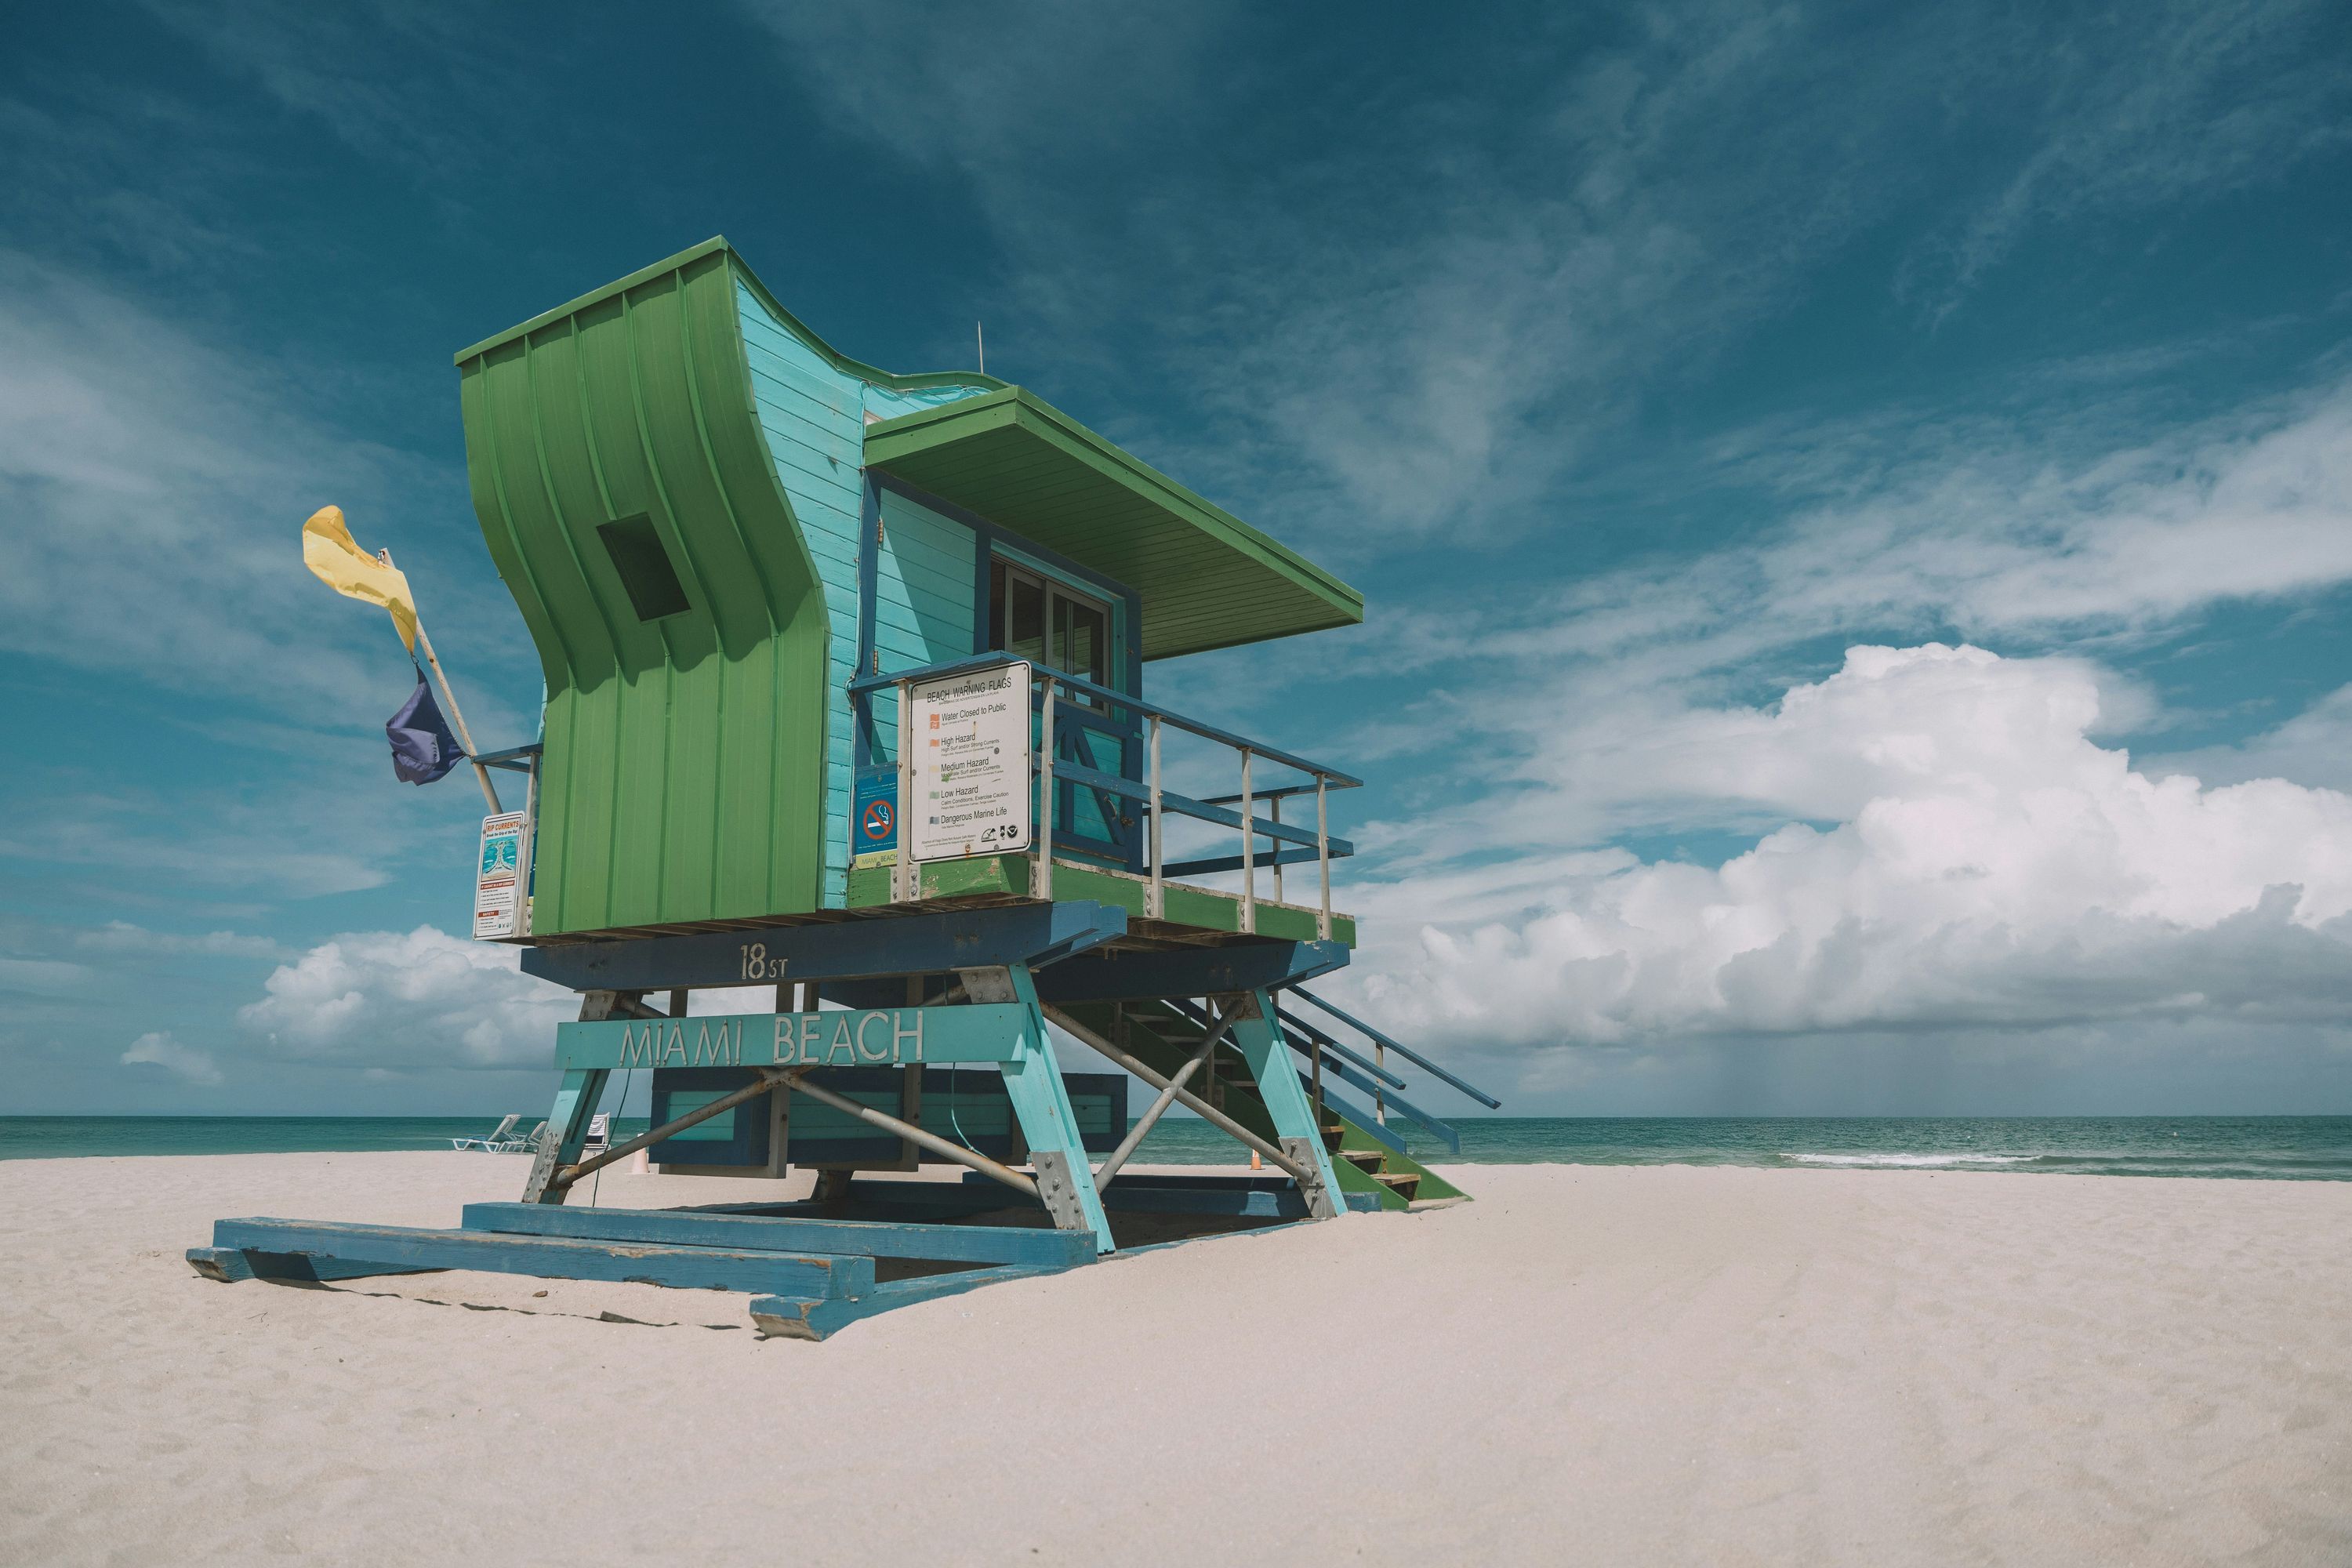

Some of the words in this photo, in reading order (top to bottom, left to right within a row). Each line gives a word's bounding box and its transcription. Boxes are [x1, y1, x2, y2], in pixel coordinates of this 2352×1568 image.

[927, 688, 950, 703] BEACH
[953, 682, 985, 698] WARNING
[989, 677, 1011, 691] FLAGS
[942, 712, 959, 721] Water
[960, 707, 980, 718] Closed
[988, 702, 1007, 713] Public
[941, 736, 954, 747] High
[956, 732, 975, 744] Hazard
[941, 761, 965, 772] Medium
[967, 756, 989, 768] Hazard
[941, 789, 954, 799] Low
[955, 785, 978, 796] Hazard
[941, 813, 973, 825] Dangerous
[974, 808, 994, 819] Marine
[996, 806, 1007, 816] Life
[495, 821, 519, 830] CURRENTS
[880, 853, 898, 862] BEACH
[740, 942, 766, 980] 18
[768, 958, 789, 978] ST
[619, 1019, 742, 1067] MIAMI
[773, 1010, 924, 1065] BEACH
